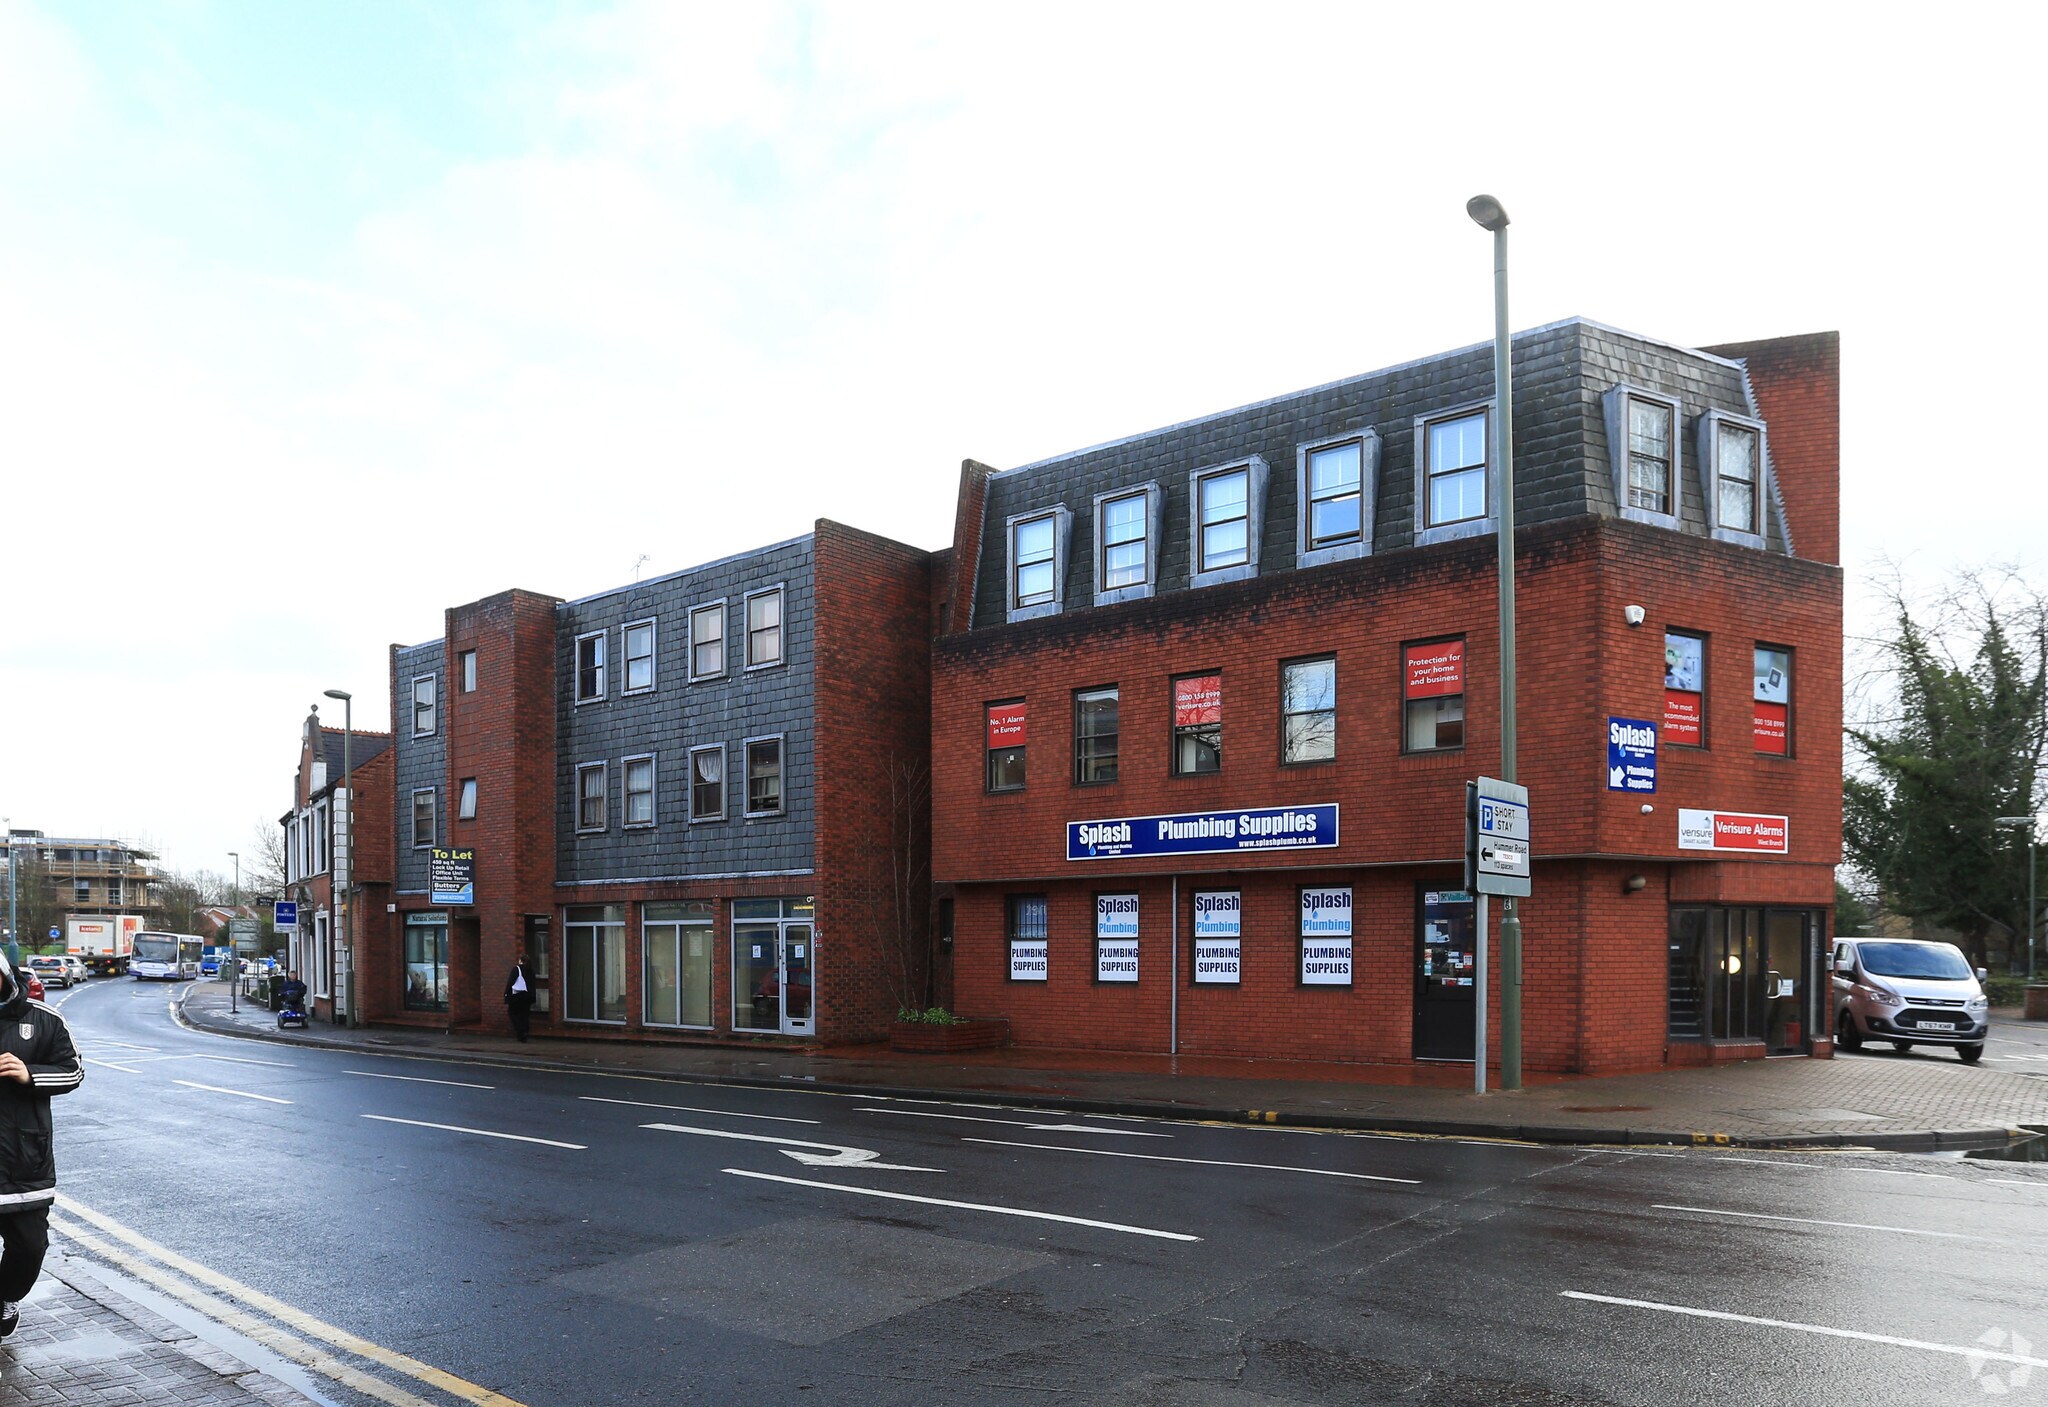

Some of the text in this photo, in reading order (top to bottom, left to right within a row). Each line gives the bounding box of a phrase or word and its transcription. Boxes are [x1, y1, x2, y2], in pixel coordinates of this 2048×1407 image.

[1408, 653, 1461, 666] Protection for
[1414, 665, 1455, 677] your home
[1410, 674, 1459, 686] and business
[1178, 694, 1193, 702] 0800
[1668, 701, 1694, 712] The most
[990, 718, 1001, 726] No.
[1007, 715, 1025, 723] Alarm
[1664, 712, 1700, 722] ecommended
[1000, 725, 1021, 734] Europe
[1664, 720, 1698, 732] alarm system
[1610, 722, 1655, 750] Splash
[1627, 764, 1655, 778] Plumbing
[1627, 777, 1653, 789] Supplies
[1484, 807, 1492, 828] P
[1494, 806, 1515, 819] SHORT
[1158, 811, 1317, 840] Plumbing Supplies
[1497, 820, 1513, 832] STAY
[1716, 821, 1783, 836] Verisure Alarms
[1079, 822, 1131, 850] Splash
[1681, 828, 1713, 838] verisure
[1238, 836, 1317, 848] www.splashplumb.co.uk
[1494, 841, 1527, 854] Hummer Road
[1769, 839, 1783, 847] Branch
[432, 849, 472, 860] To Let
[1098, 898, 1138, 917] Splash
[1196, 895, 1240, 916] Splash
[1303, 892, 1351, 913] Splash
[1098, 922, 1138, 934] Plumbing
[1196, 921, 1239, 933] Plumbing
[1303, 919, 1351, 932] Plumbing
[1012, 948, 1047, 958] PLUMBING
[1099, 948, 1139, 958] PLUMBING
[1196, 947, 1240, 958] PLUMBING
[1303, 947, 1351, 959] PLUMBING
[1013, 961, 1046, 971] SUPPLIES
[1101, 962, 1136, 972] SUPPLIES
[1198, 962, 1238, 973] SUPPLIES
[1305, 962, 1349, 974] SUPPLIES
